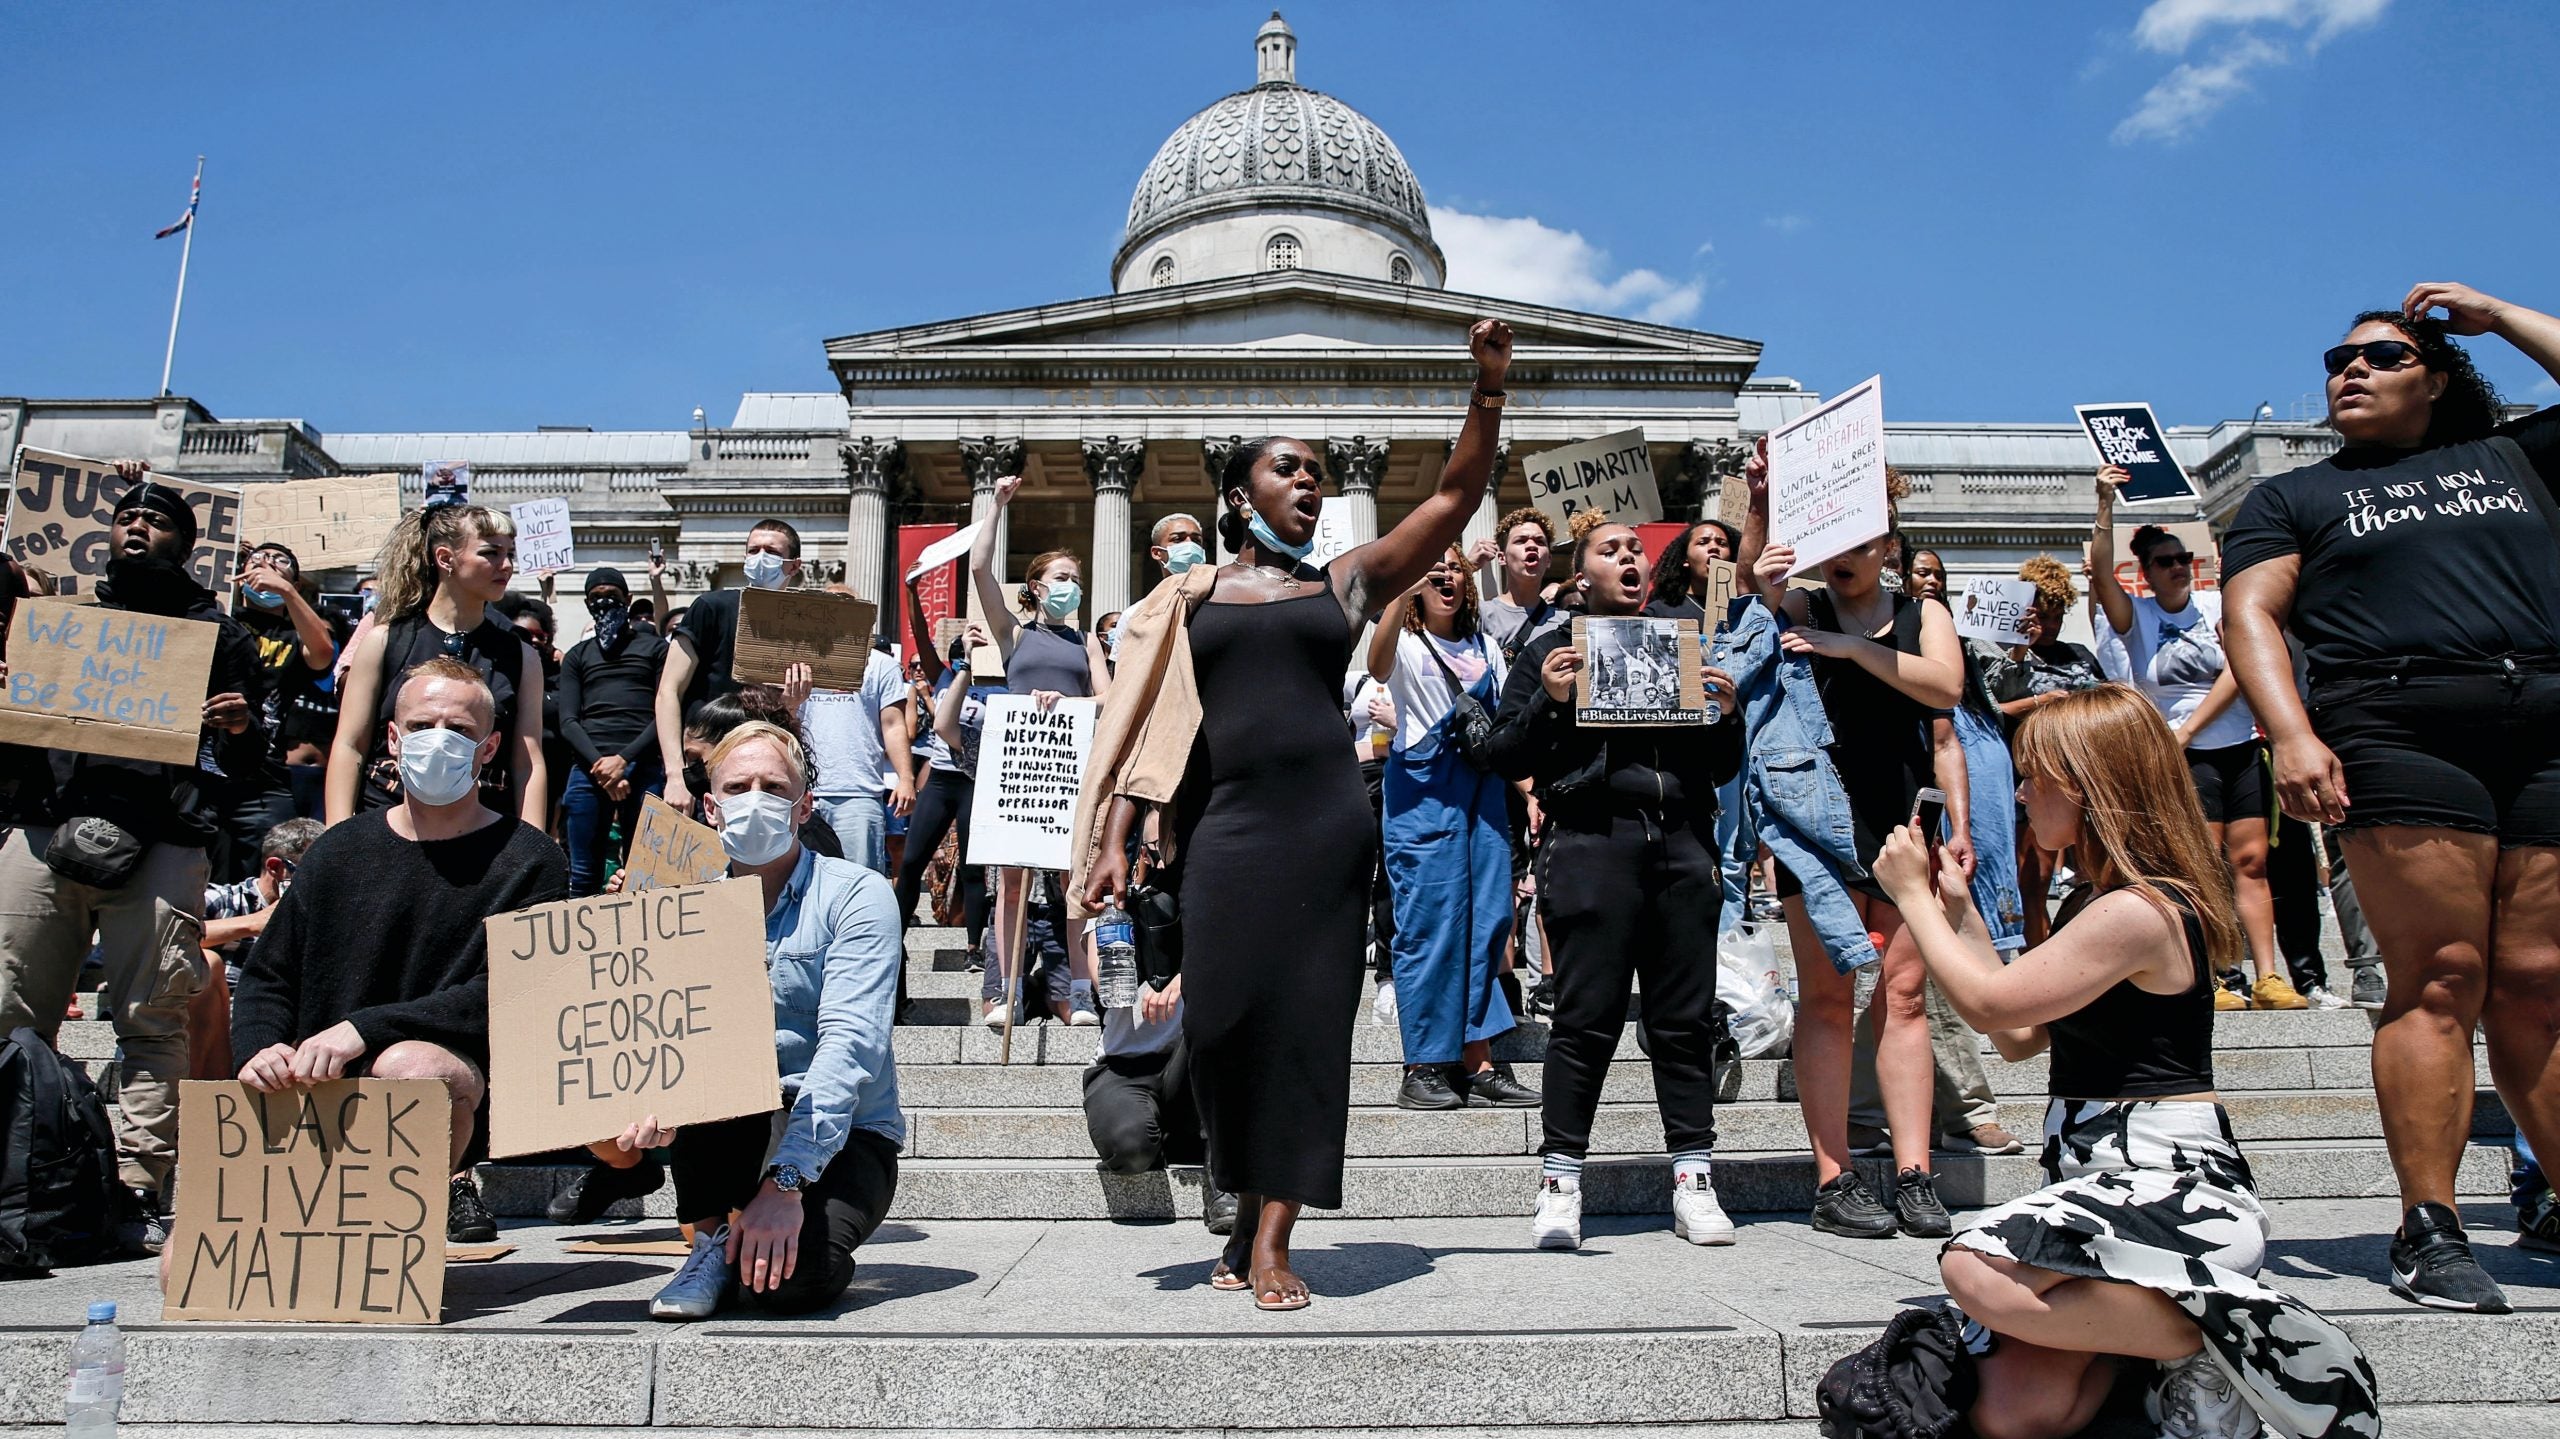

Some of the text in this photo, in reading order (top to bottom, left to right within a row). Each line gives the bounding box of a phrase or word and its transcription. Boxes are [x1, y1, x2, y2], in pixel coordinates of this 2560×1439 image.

[1043, 387, 1546, 409] THE NATIONAL GALLRY
[2088, 415, 2127, 430] STAY
[2094, 427, 2151, 442] BLACK
[1817, 415, 1870, 460] BREATHE
[2101, 439, 2138, 453] STAY
[1530, 445, 1649, 499] SOLIDARITY
[1781, 440, 1877, 498] UNTILL ALL RACES
[16, 459, 240, 544] JUSCE
[2342, 488, 2375, 509] IF
[2383, 480, 2428, 499] NOT
[516, 503, 562, 520] I WILL
[2343, 487, 2529, 538] then when?
[526, 519, 554, 535] NOT
[8, 523, 70, 562] FOR
[533, 538, 552, 551] BE
[69, 530, 236, 593] GGE
[522, 546, 571, 571] SILENT
[1968, 578, 2005, 597] BLACK
[1977, 599, 2020, 617] LIVES
[27, 607, 168, 661] We Will
[80, 655, 150, 690] Not
[9, 672, 180, 725] Be Silent
[1006, 711, 1017, 723] IF
[1048, 713, 1074, 730] ARE
[1581, 709, 1701, 721] #BlackLivesMatter
[1004, 728, 1073, 747] NEUTRAL
[1003, 746, 1018, 757] IN
[1000, 771, 1020, 783] YOU
[1023, 772, 1050, 782] HAVE
[1002, 760, 1078, 775] OF INJUSTICE
[1000, 783, 1080, 796] THE SIDE OF THE
[998, 797, 1069, 811] OPPRESSOR
[639, 805, 664, 854] The
[666, 823, 703, 873] UK
[1041, 825, 1070, 835] TUTU
[511, 890, 706, 961] JUSTICE
[589, 947, 655, 990] FOR
[557, 984, 713, 1056] GEORGE
[558, 1043, 685, 1106] FLOYD
[215, 1091, 421, 1159] BLACK
[216, 1164, 428, 1234] LIVES
[179, 1226, 432, 1319] MATTER
